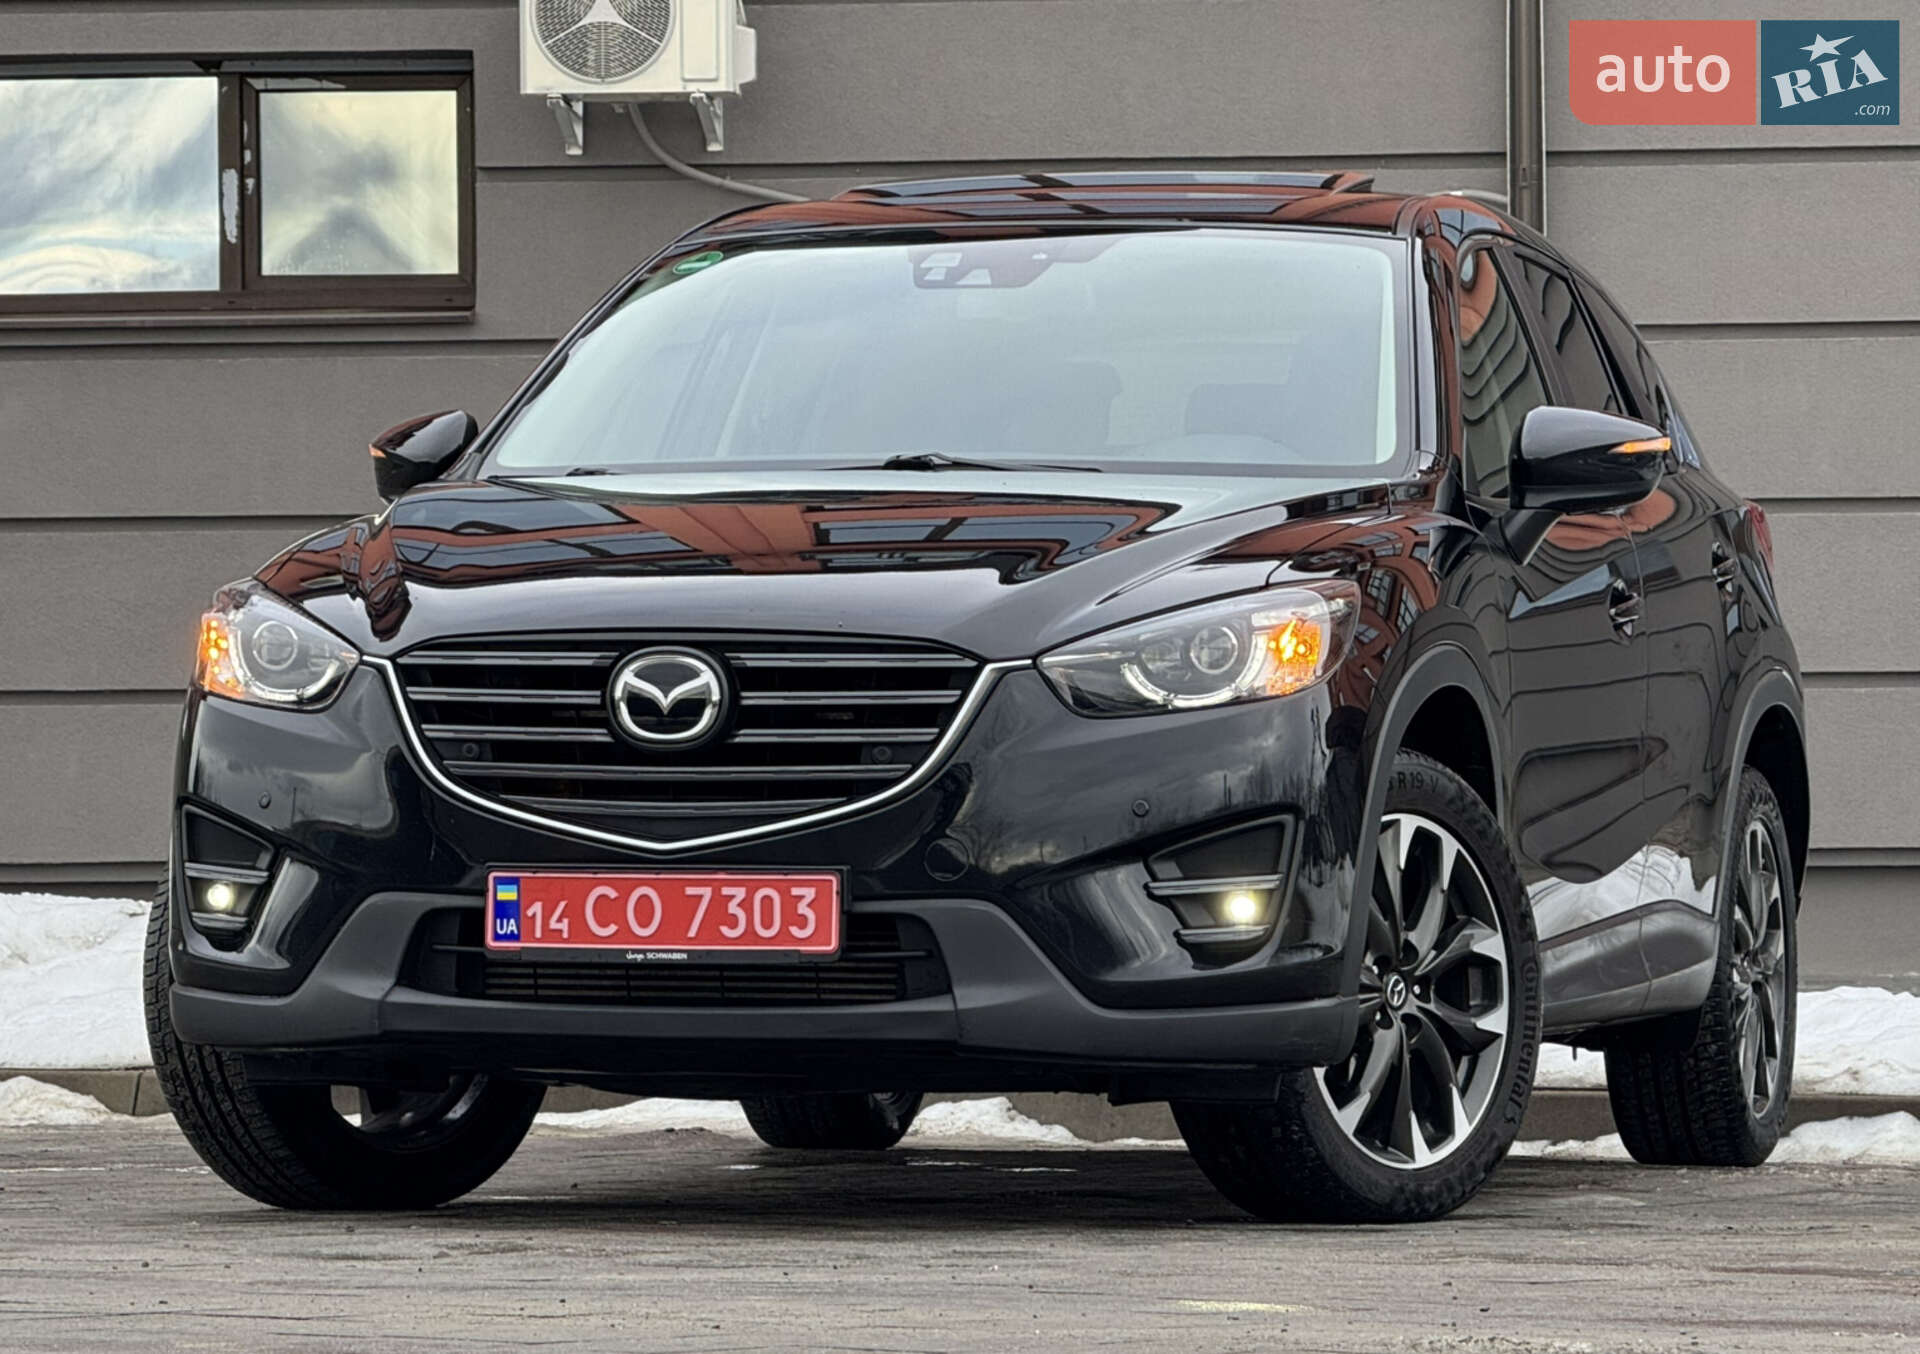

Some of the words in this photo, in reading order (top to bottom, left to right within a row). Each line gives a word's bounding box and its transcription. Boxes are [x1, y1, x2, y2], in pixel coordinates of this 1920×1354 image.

[496, 918, 518, 935] UA
[526, 899, 570, 939] 14
[584, 885, 662, 938] CO
[684, 886, 817, 939] 7303
[646, 951, 688, 960] SCHWABEN
[1509, 957, 1539, 1108] Continental
